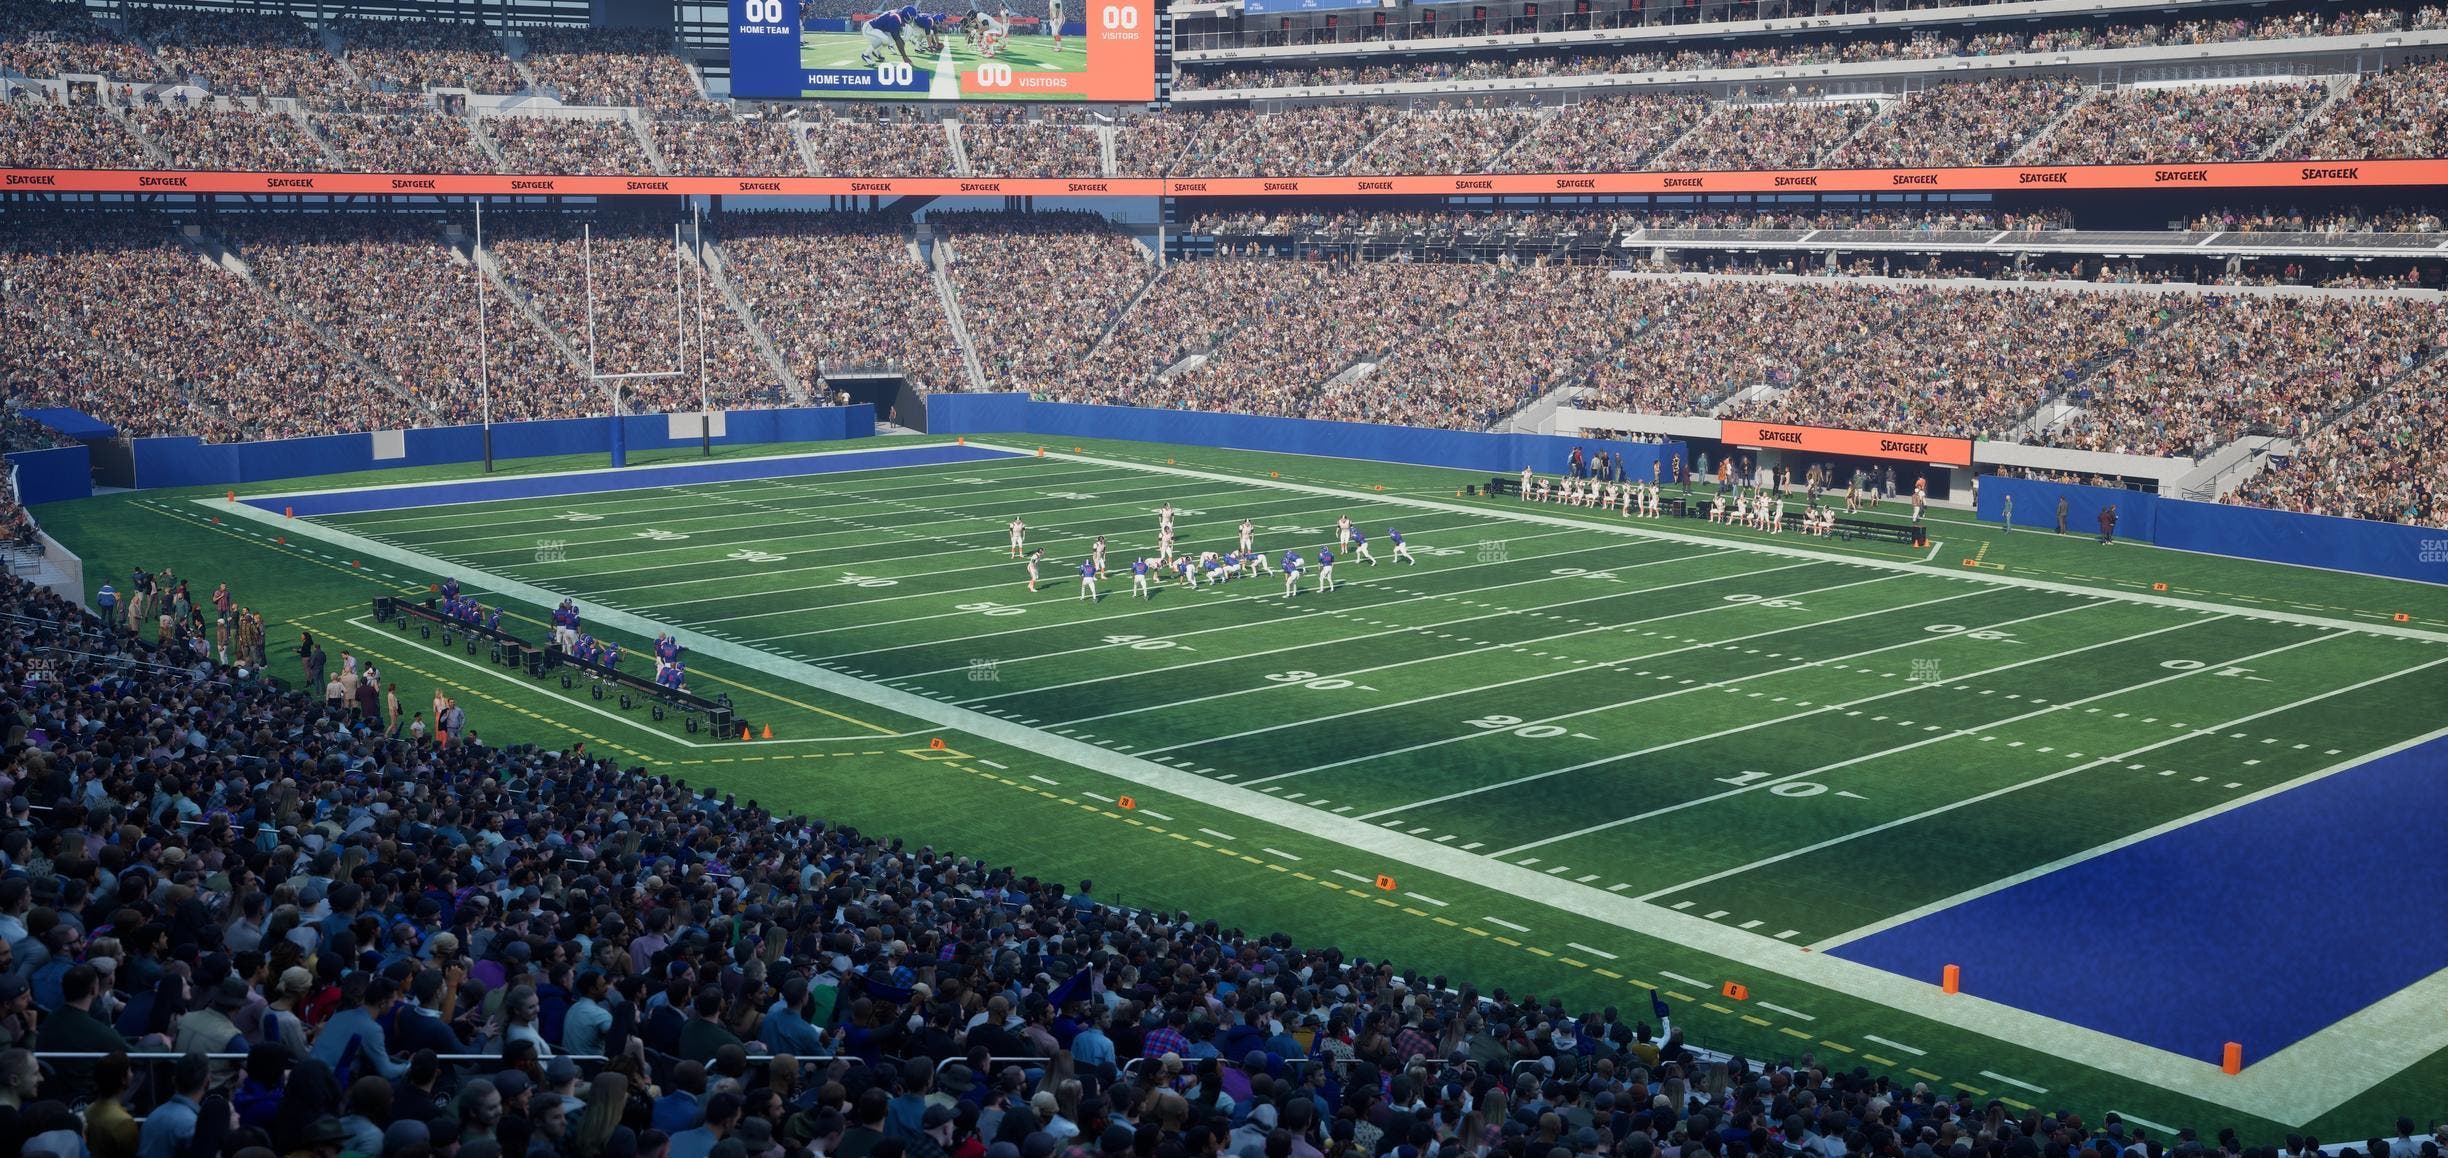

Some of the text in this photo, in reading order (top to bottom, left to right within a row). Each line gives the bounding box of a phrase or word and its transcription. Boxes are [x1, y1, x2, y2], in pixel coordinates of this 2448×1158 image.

[746, 0, 782, 23] 00
[1103, 6, 1138, 29] 00
[740, 26, 790, 35] HOME TEAM
[1101, 32, 1139, 40] VISITORS
[809, 62, 913, 86] HOME TEAM 00
[977, 63, 1068, 87] 00 VISITORS
[2019, 172, 2068, 184] SEATGEEK
[2154, 170, 2208, 182] SEATGEEK
[2301, 167, 2359, 180] SEATGEEK
[5, 174, 56, 186] SEATGEEK
[138, 176, 188, 187] SEATGEEK
[267, 177, 314, 188] SEATGEEK
[391, 179, 436, 189] SEATGEEK
[511, 180, 554, 190] SEATGEEK
[1456, 180, 1492, 189] SEATGEEK
[1556, 179, 1594, 188] SEATGEEK
[1663, 177, 1703, 188] SEATGEEK
[1774, 176, 1817, 187] SEATGEEK
[1892, 174, 1938, 185] SEATGEEK
[626, 181, 669, 191] SEATGEEK
[739, 182, 781, 191] SEATGEEK
[851, 183, 891, 191] SEATGEEK
[960, 183, 1000, 191] SEATGEEK
[1068, 183, 1108, 192] SEATGEEK
[1174, 183, 1207, 192] SEATGEEK
[1264, 182, 1299, 191] SEATGEEK
[1358, 181, 1393, 191] SEATGEEK
[1758, 429, 1803, 444] SEATGEEK
[1880, 440, 1928, 456] SEATGEEK
[1724, 594, 1803, 608] 30
[955, 601, 1027, 616] 50
[1924, 624, 2017, 640] 20
[1101, 635, 1177, 650] 40
[1264, 671, 1355, 690] 30
[1461, 715, 1568, 738] 20
[1713, 770, 1829, 797] 10
[1380, 877, 1388, 887] 10
[1729, 985, 1738, 996] G
